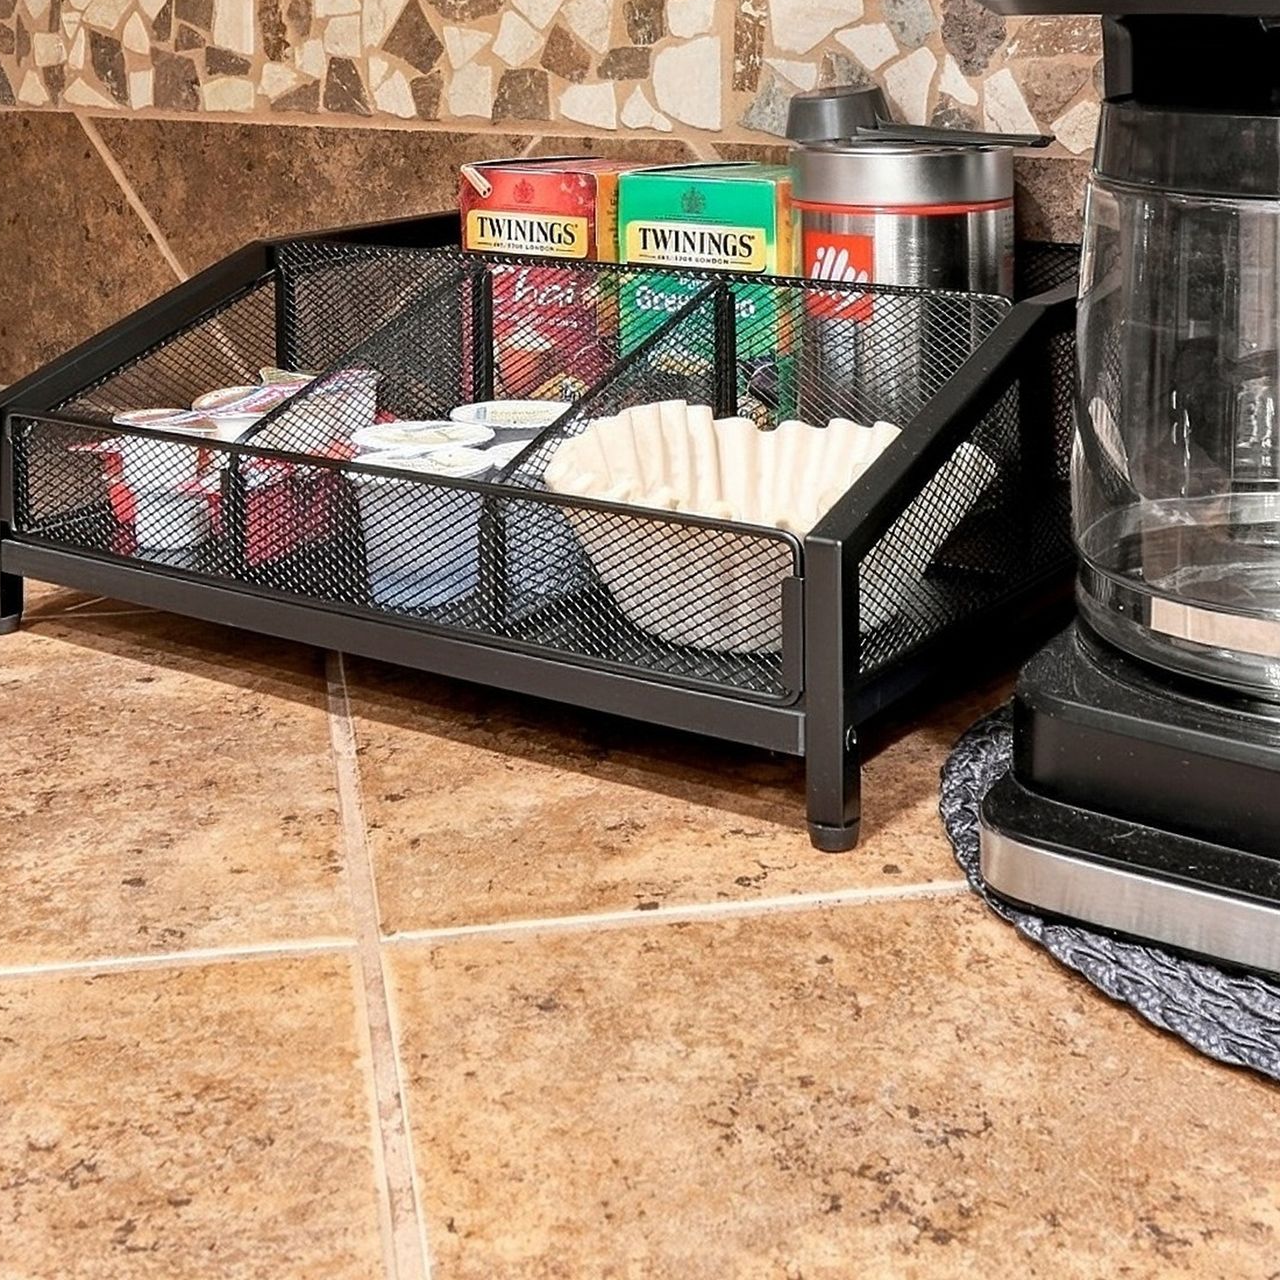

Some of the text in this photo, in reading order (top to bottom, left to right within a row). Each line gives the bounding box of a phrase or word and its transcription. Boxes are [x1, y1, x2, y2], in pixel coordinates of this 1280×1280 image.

[476, 215, 576, 246] TWININGS
[638, 227, 754, 258] TWININGS
[809, 245, 869, 312] illy
